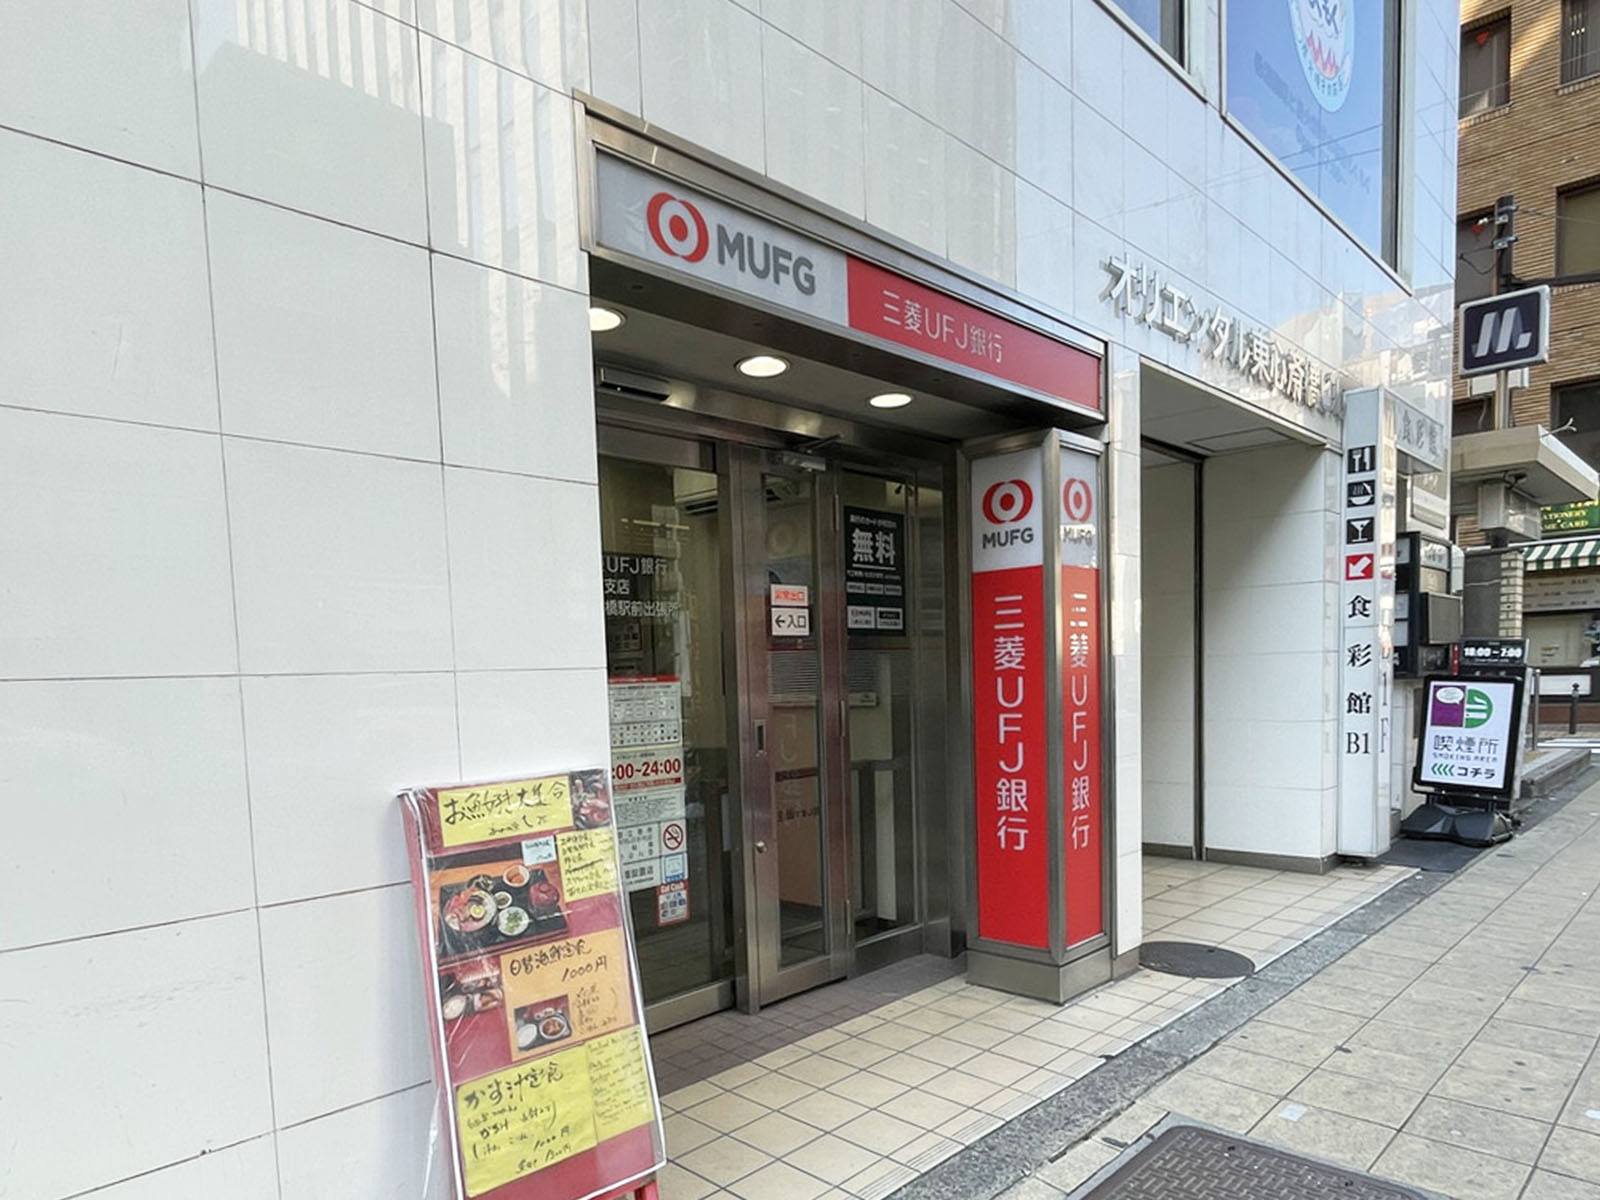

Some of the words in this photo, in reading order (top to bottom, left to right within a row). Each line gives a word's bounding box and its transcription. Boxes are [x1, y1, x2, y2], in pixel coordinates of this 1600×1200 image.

[717, 223, 816, 296] MUFG
[882, 290, 1003, 363] 三菱UFJ銀行
[852, 528, 896, 565] 無料
[982, 527, 1034, 549] MUFG
[1063, 526, 1092, 547] MUFG
[602, 556, 668, 576] UFJ銀行
[604, 578, 630, 595] 支店
[787, 614, 806, 628] 入口
[1347, 595, 1372, 714] 食彩館
[994, 595, 1029, 851] 三菱UFJ銀行
[1069, 593, 1091, 850] 三菱UFJ銀行
[1346, 731, 1370, 755] B1
[1433, 735, 1500, 754] 喫煙所
[1457, 766, 1495, 779] コチラ
